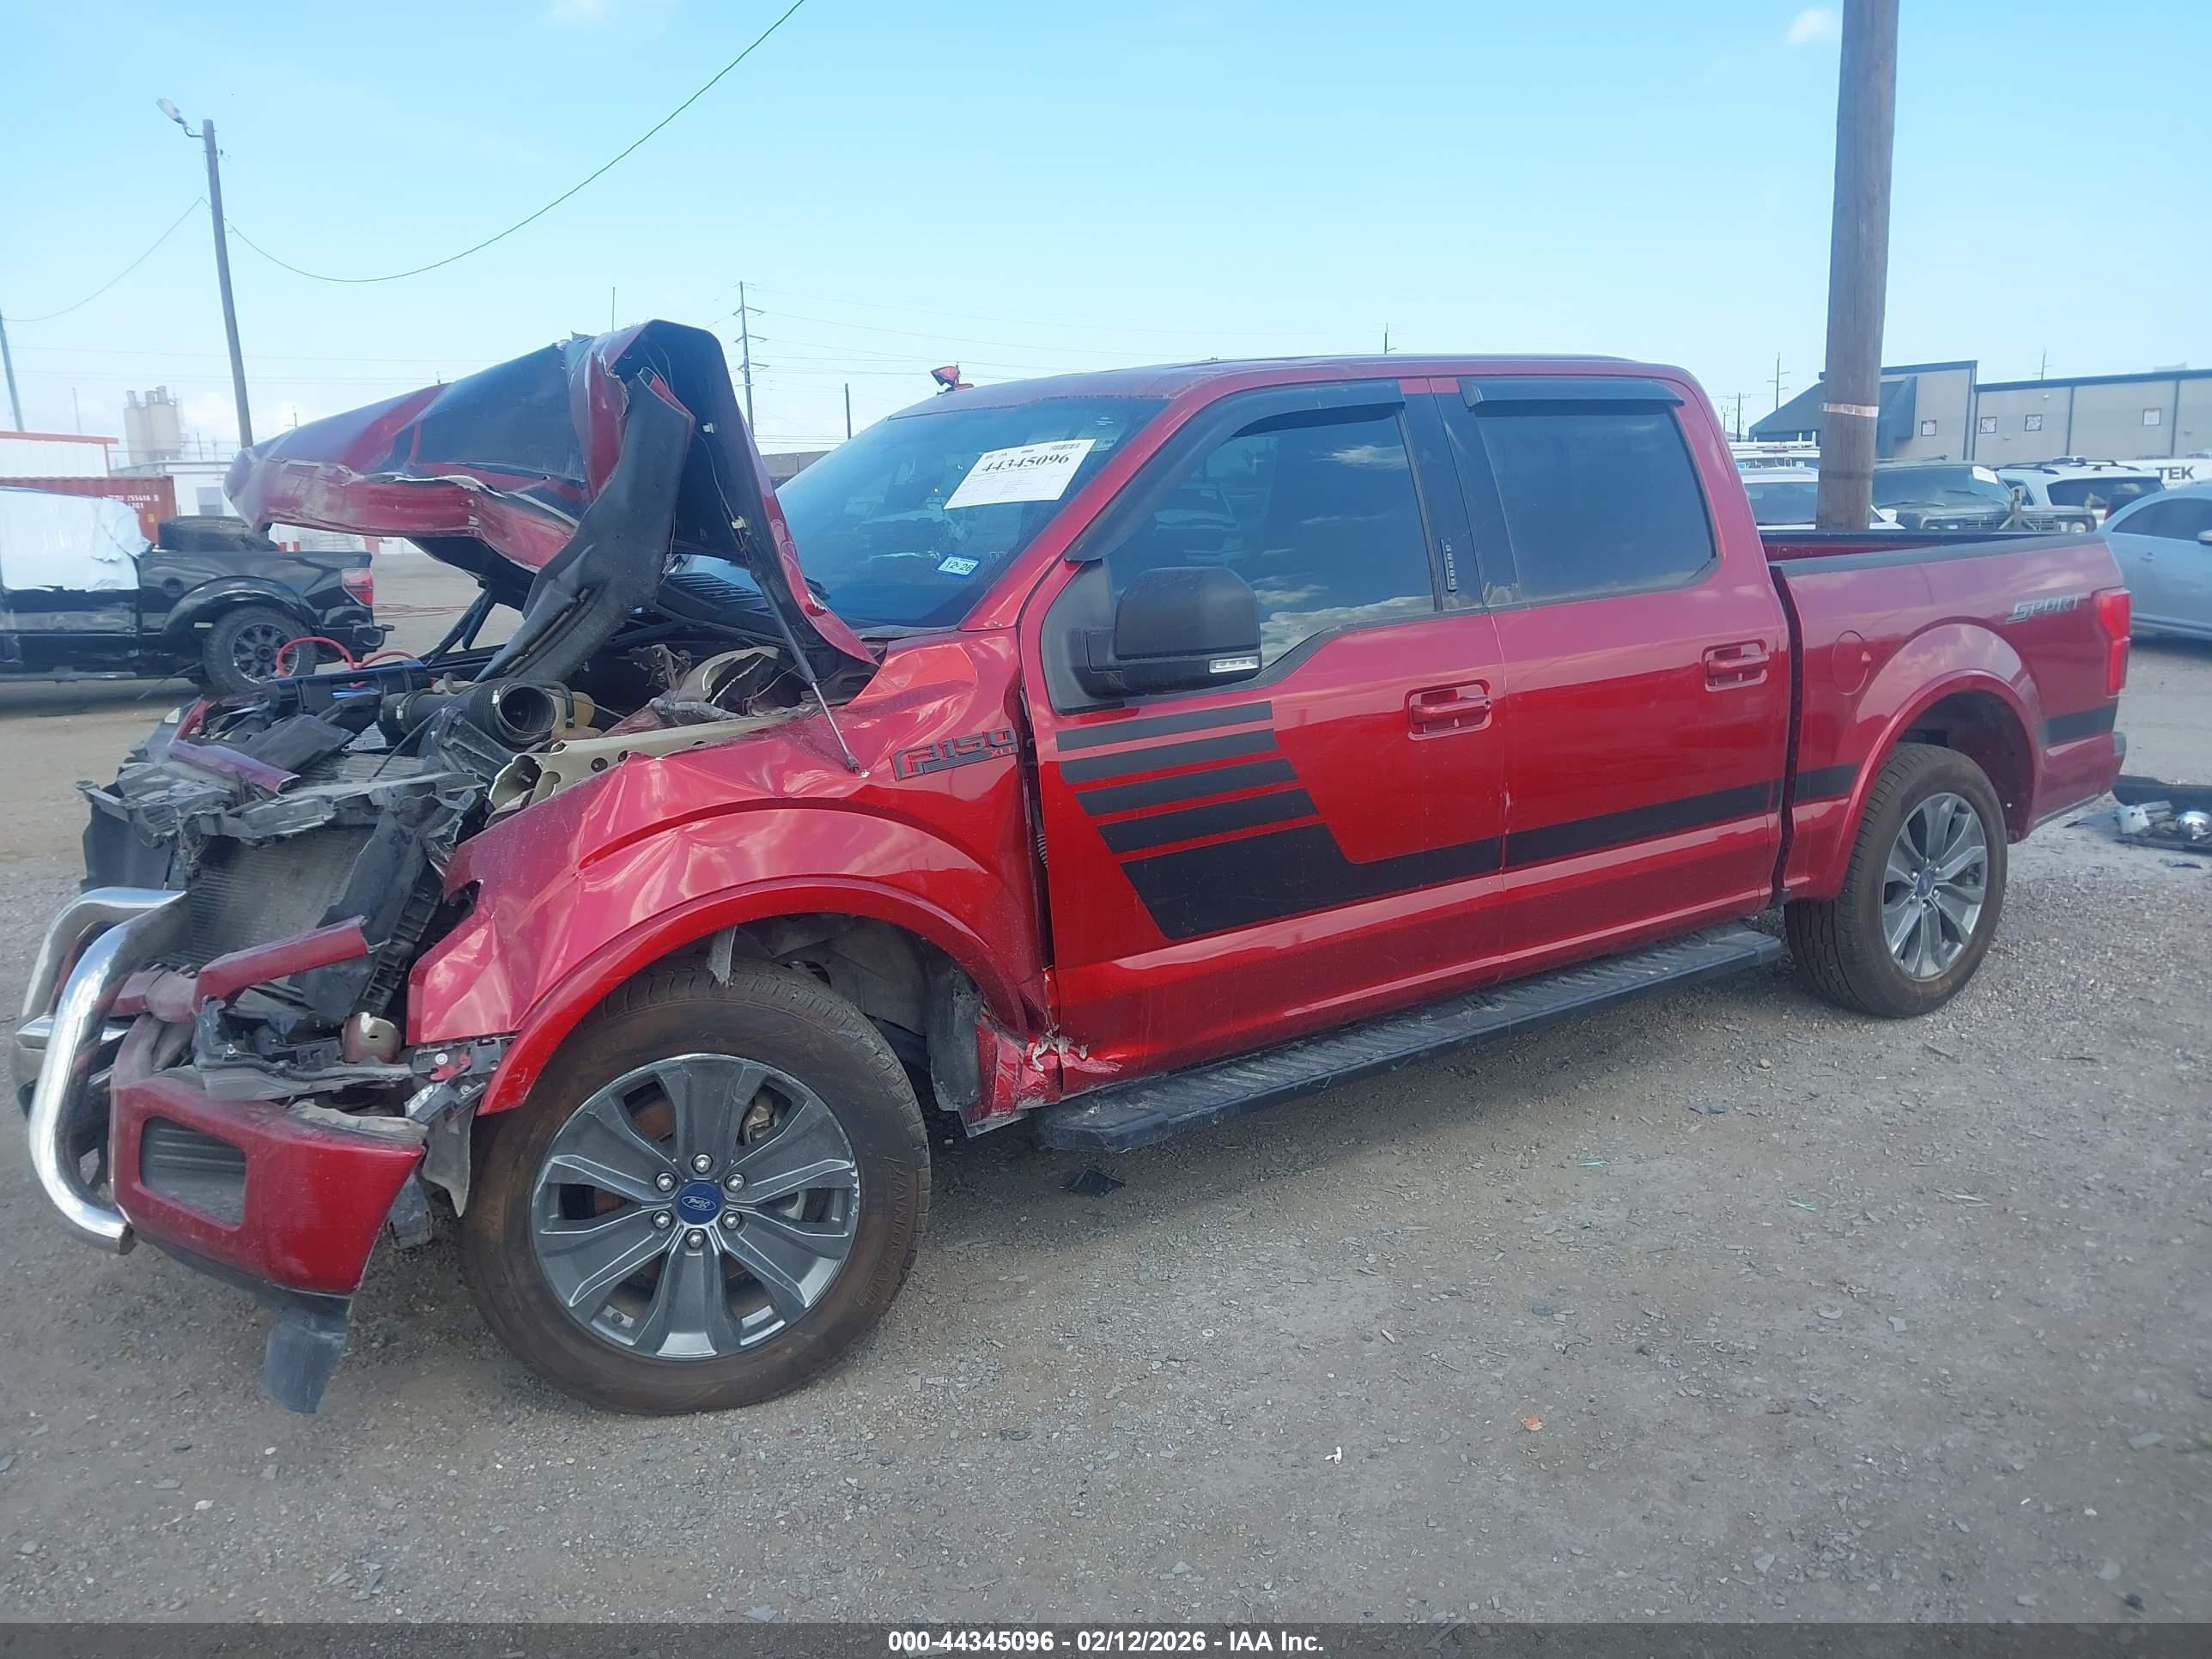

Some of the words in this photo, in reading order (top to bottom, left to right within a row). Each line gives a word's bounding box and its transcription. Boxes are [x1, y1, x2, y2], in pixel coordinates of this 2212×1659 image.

[981, 453, 1072, 472] 44345096
[2006, 593, 2087, 623] SPORT
[687, 1198, 711, 1210] Ford
